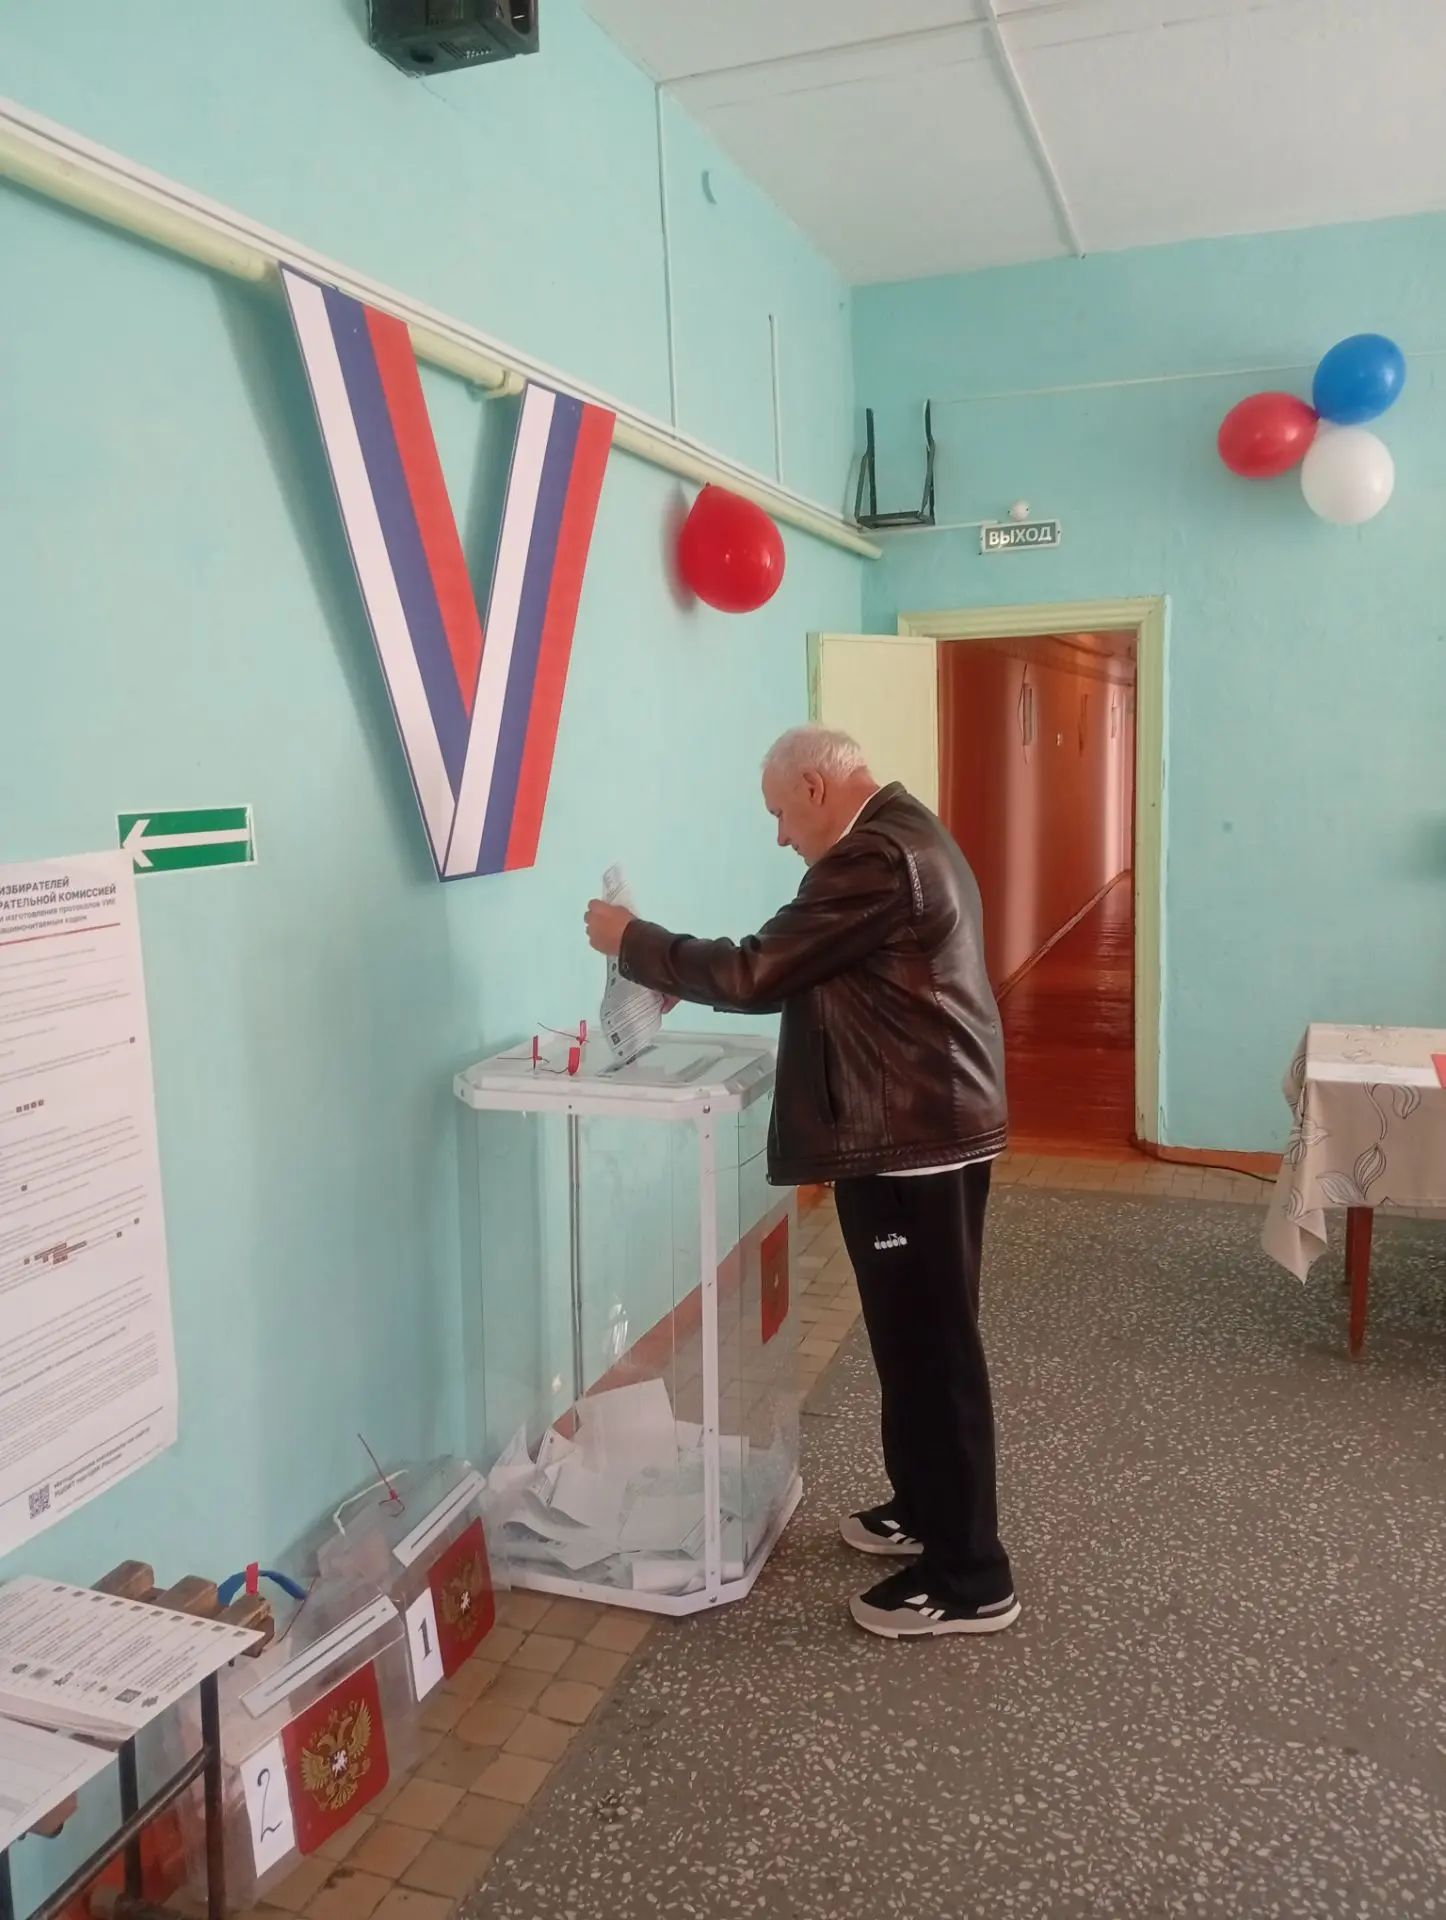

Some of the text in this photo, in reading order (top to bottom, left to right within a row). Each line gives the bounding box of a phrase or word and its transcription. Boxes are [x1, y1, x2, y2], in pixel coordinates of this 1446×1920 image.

[989, 527, 1052, 545] ВЫХОД
[58, 883, 116, 902] КОМИССИЕЙ
[417, 1617, 433, 1661] 1
[257, 1767, 283, 1843] 2
